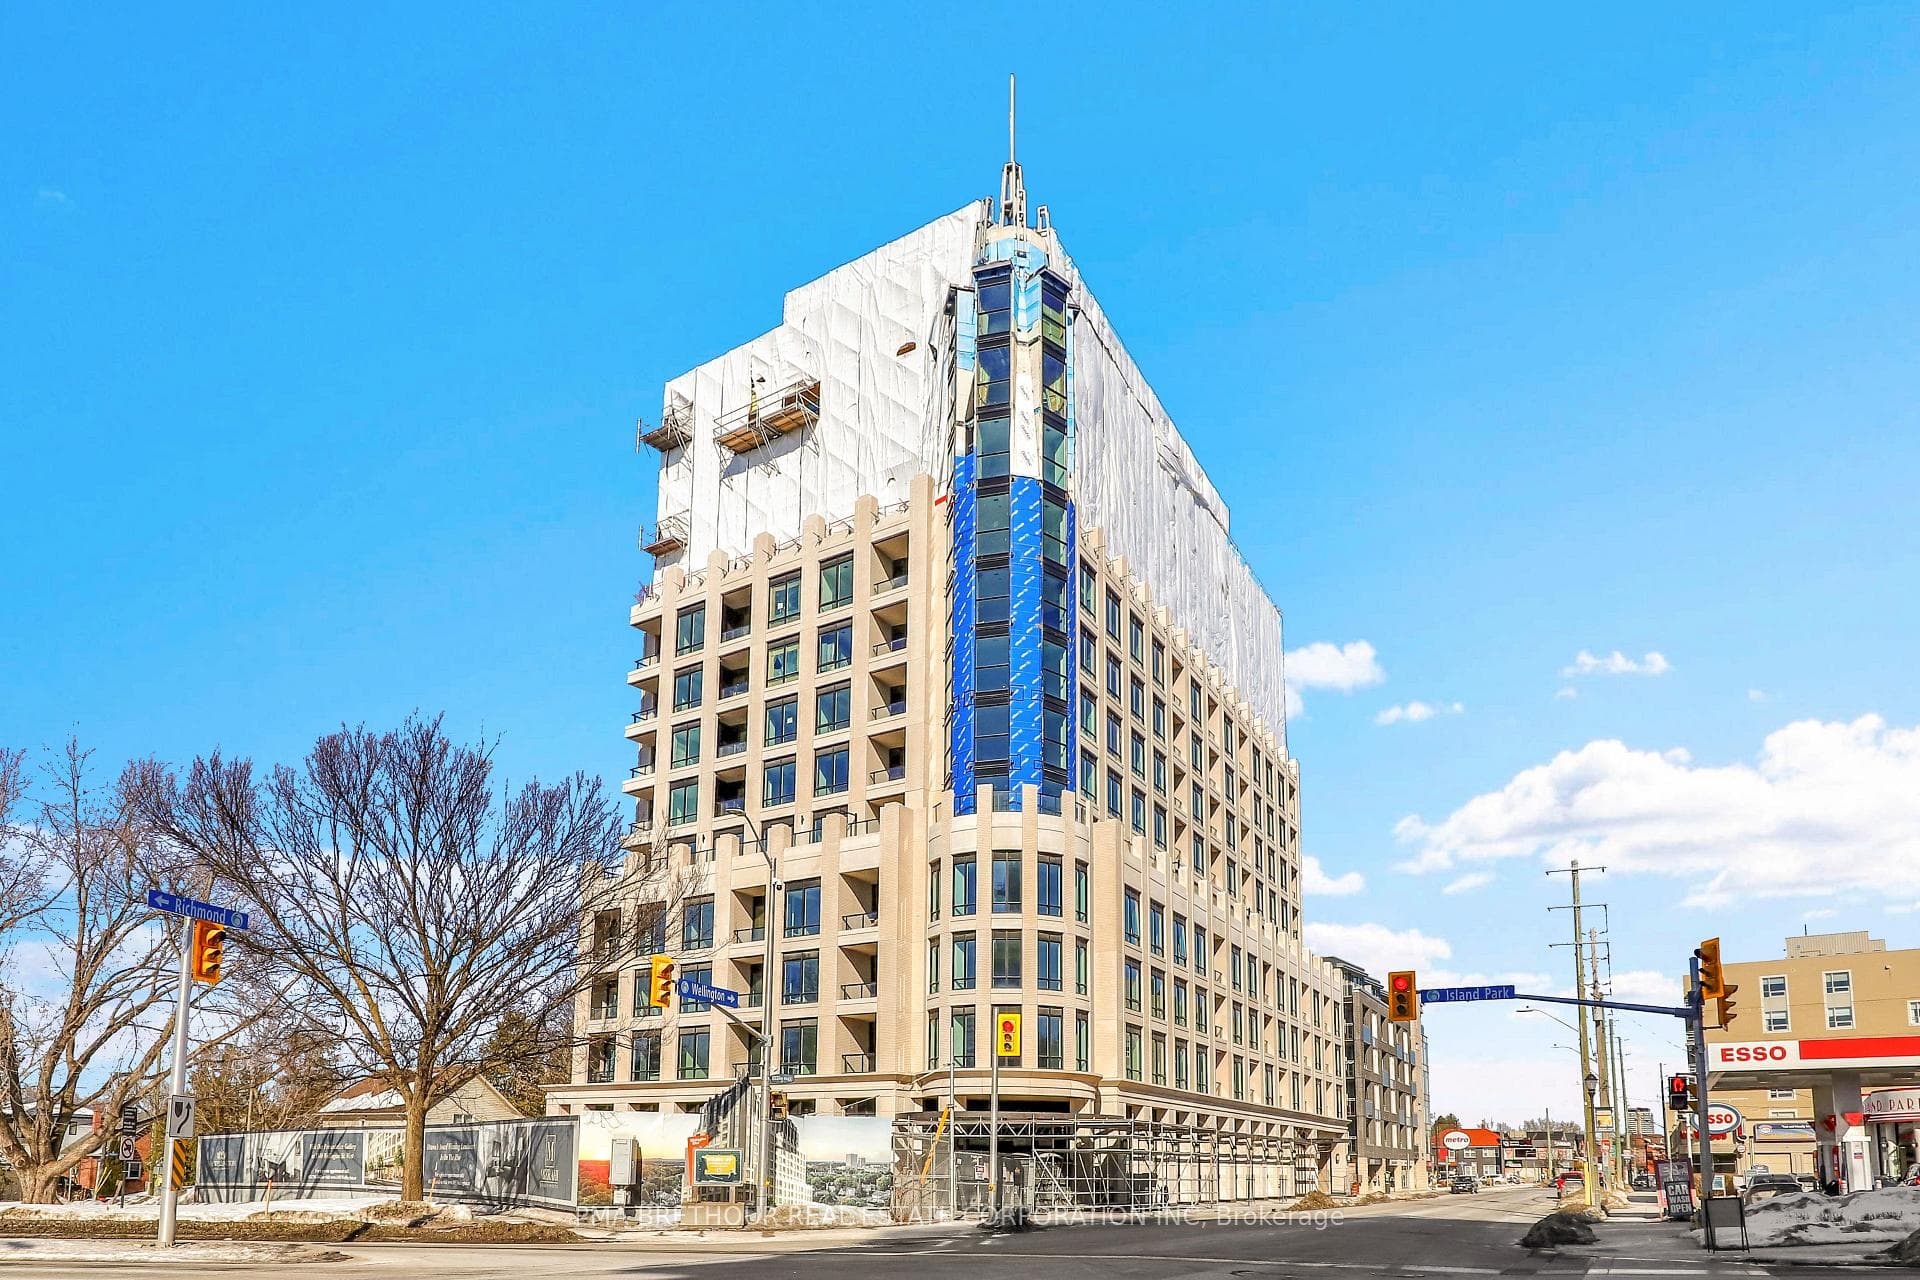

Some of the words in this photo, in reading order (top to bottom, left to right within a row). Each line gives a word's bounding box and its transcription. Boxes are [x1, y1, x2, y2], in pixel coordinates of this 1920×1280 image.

[175, 898, 226, 924] Richmond
[691, 983, 725, 1002] Wellington
[1446, 988, 1479, 1001] Island
[1485, 987, 1509, 999] Park
[1720, 1046, 1787, 1062] ESSO
[1889, 1098, 1920, 1110] PAR
[1707, 1113, 1733, 1124] SSO
[1668, 1184, 1689, 1196] CAR
[1670, 1203, 1692, 1213] OPEN
